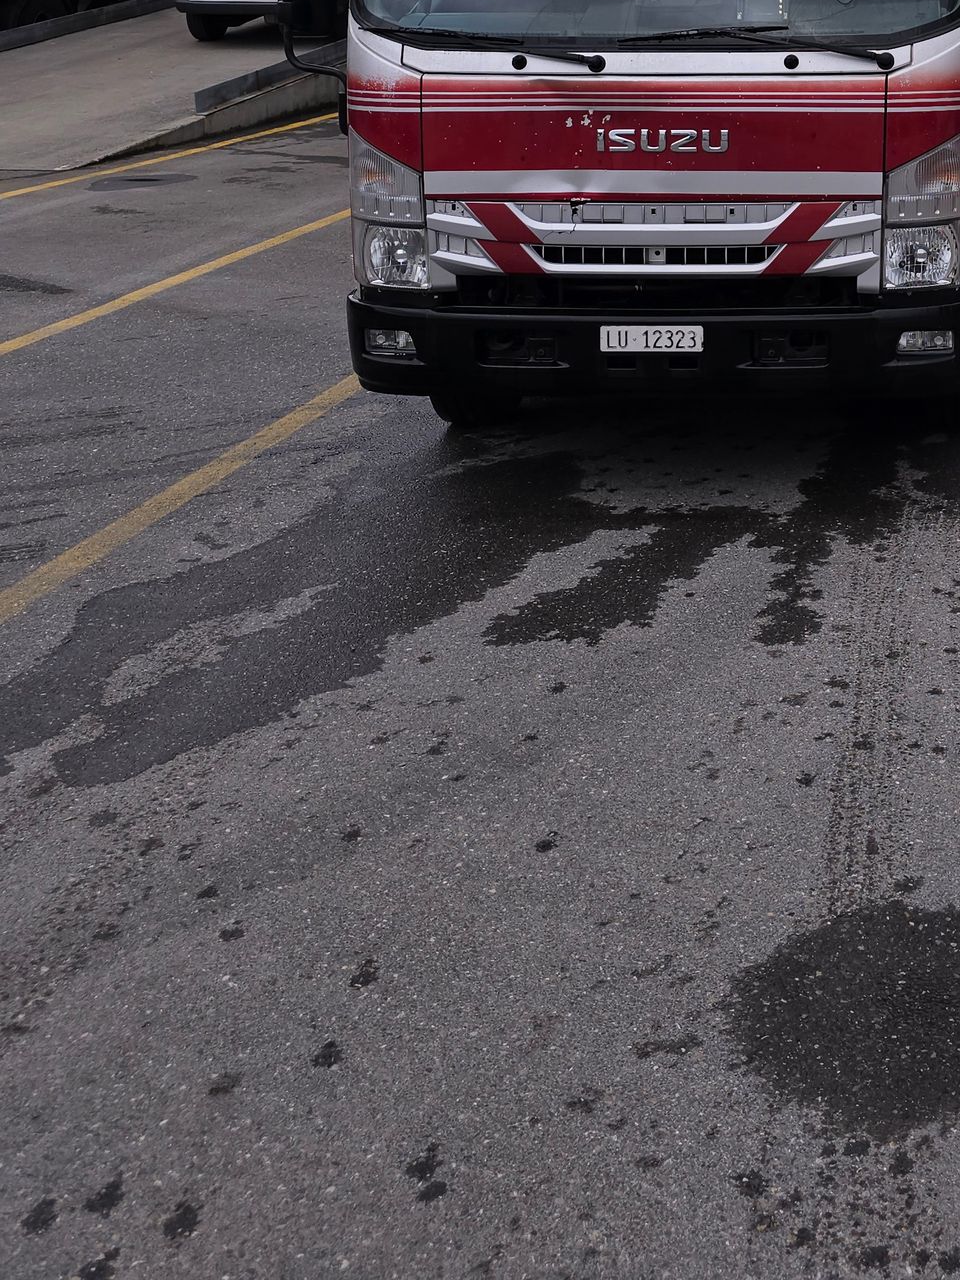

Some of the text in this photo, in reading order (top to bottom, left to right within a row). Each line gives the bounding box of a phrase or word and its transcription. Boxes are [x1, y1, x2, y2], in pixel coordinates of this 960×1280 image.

[596, 128, 729, 152] ISUZU
[607, 329, 697, 349] LU 12323
